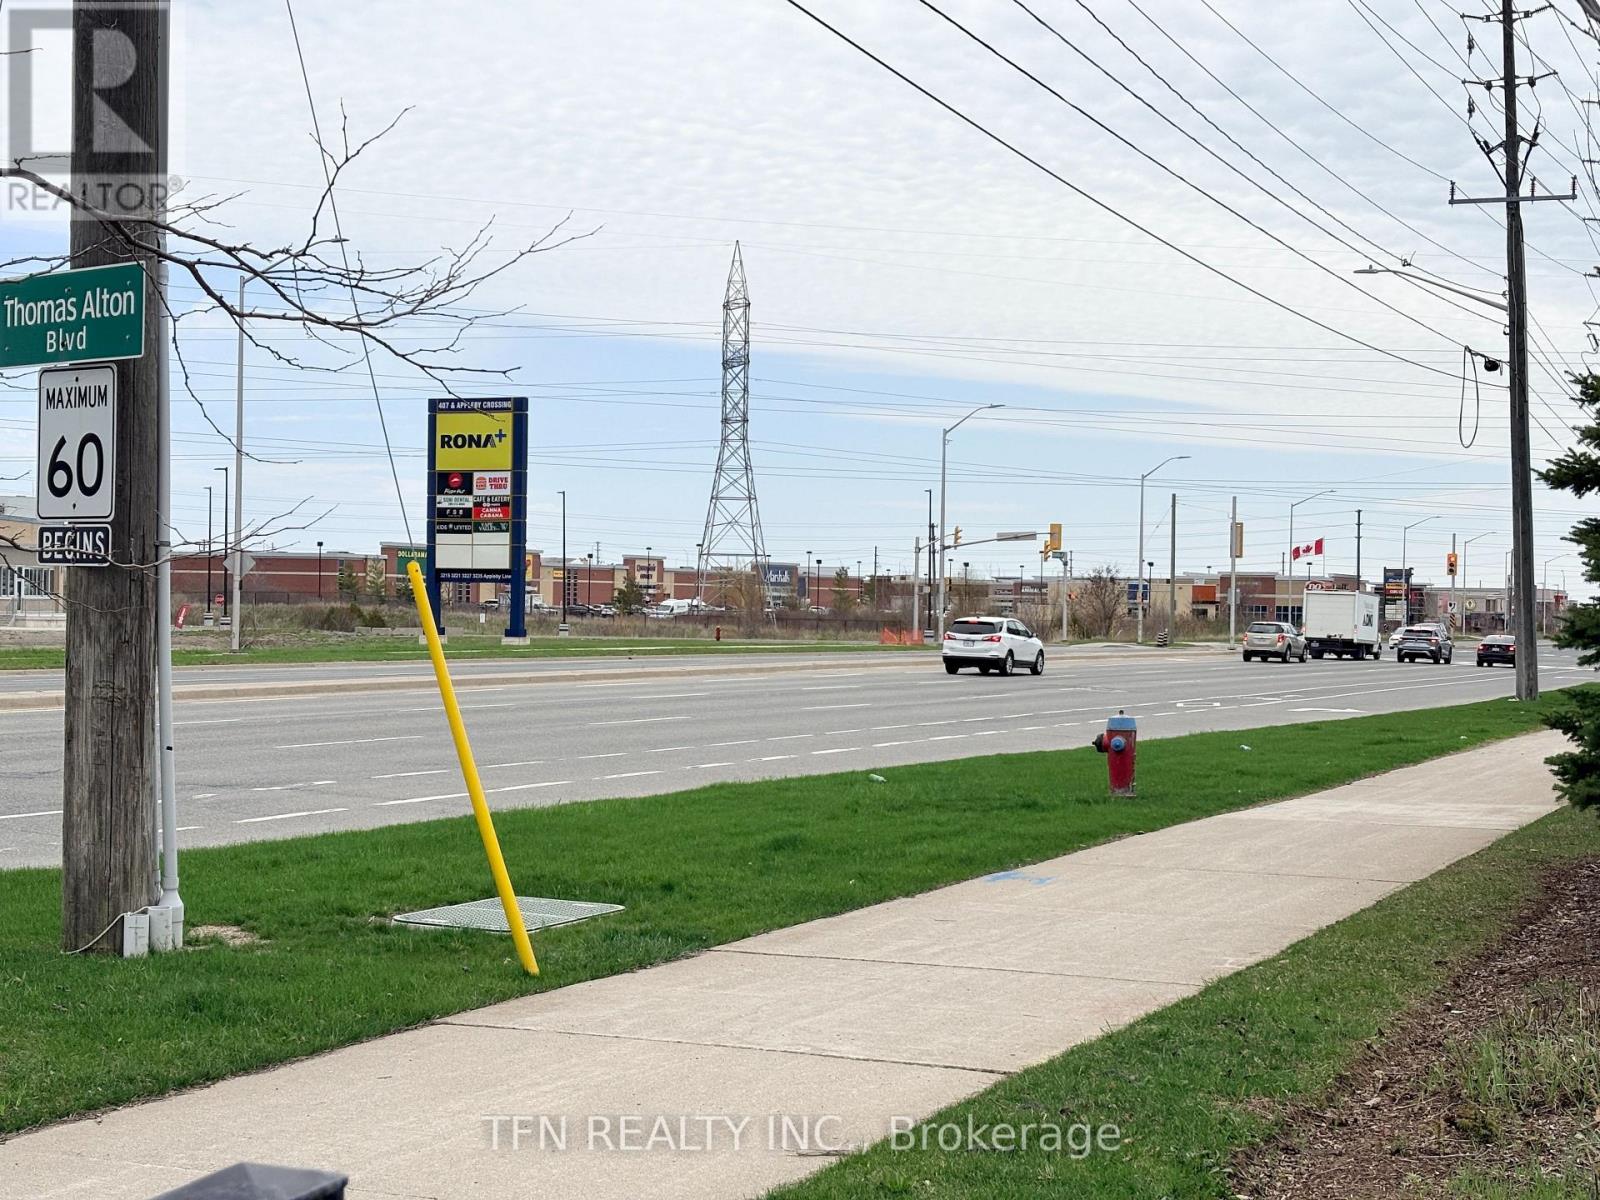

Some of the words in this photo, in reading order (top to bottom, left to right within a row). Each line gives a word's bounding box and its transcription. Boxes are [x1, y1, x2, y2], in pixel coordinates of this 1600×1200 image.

[4, 297, 77, 327] Thomas
[81, 287, 135, 319] Alton
[46, 326, 87, 352] Blvd
[46, 385, 107, 410] MAXIMUM
[47, 433, 104, 497] 60
[43, 532, 105, 559] BEGINS
